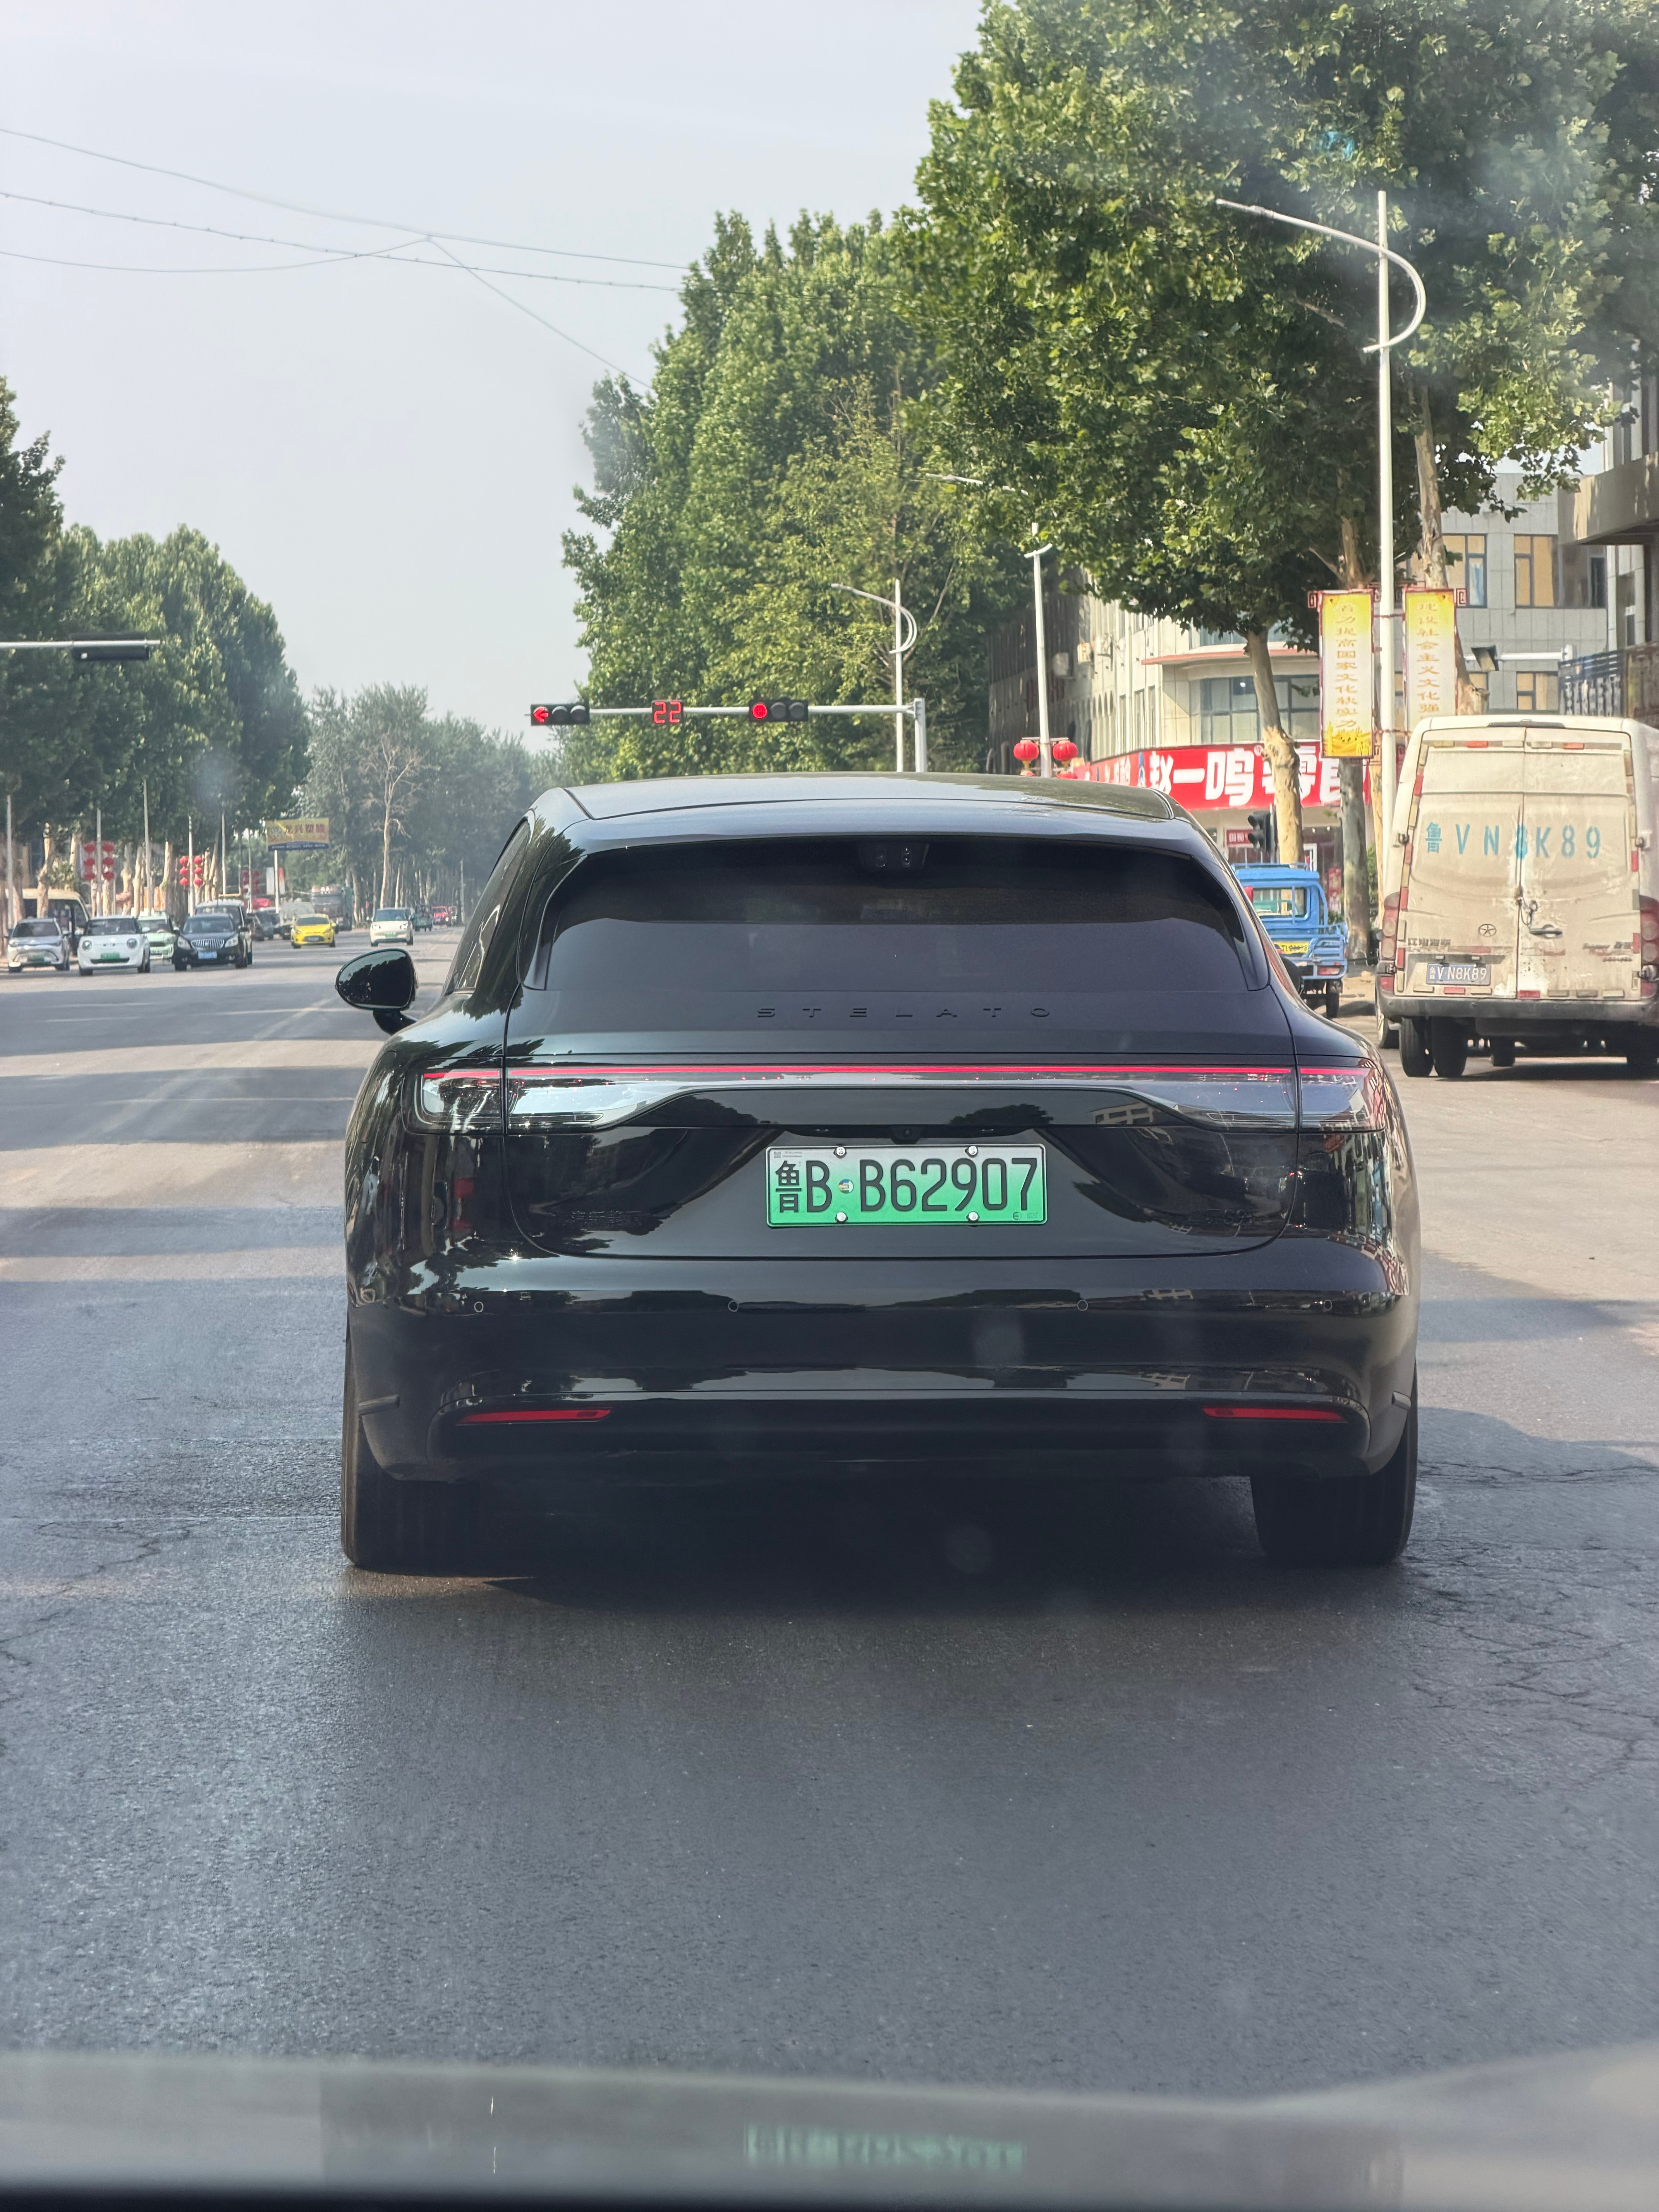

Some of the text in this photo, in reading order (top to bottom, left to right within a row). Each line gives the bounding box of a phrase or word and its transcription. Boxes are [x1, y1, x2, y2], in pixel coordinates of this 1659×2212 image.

[1416, 602, 1440, 720] 建设社会主义文化强
[654, 701, 681, 723] 22
[757, 1008, 1050, 1018] STELATO
